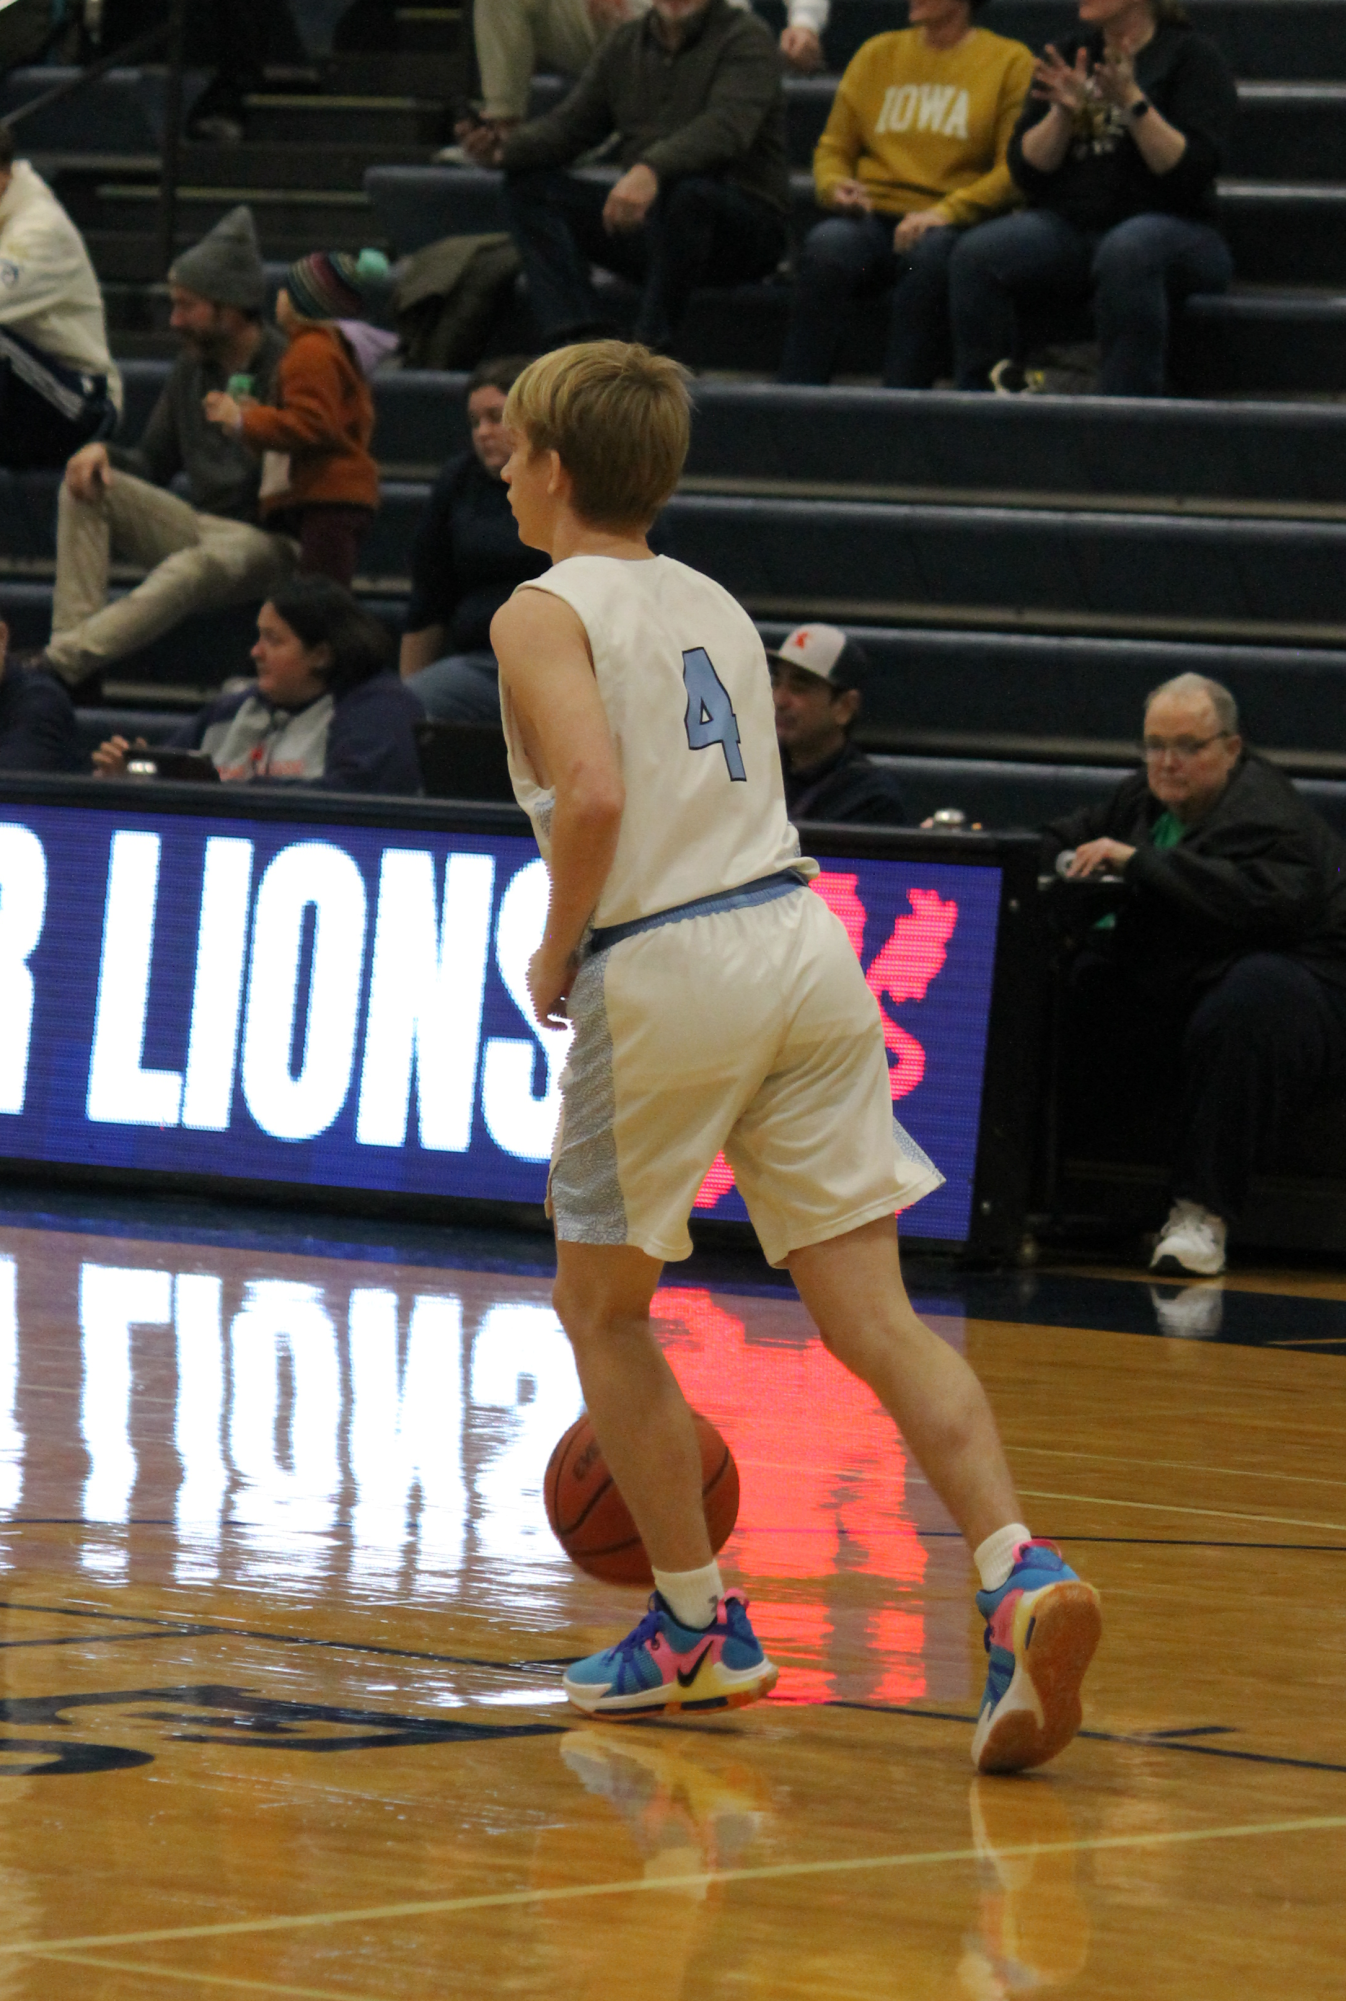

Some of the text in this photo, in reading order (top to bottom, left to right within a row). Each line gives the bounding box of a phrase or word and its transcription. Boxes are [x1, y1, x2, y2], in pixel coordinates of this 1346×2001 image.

[874, 83, 969, 139] IOWA
[682, 647, 747, 782] 4
[86, 829, 575, 1163] LIONS
